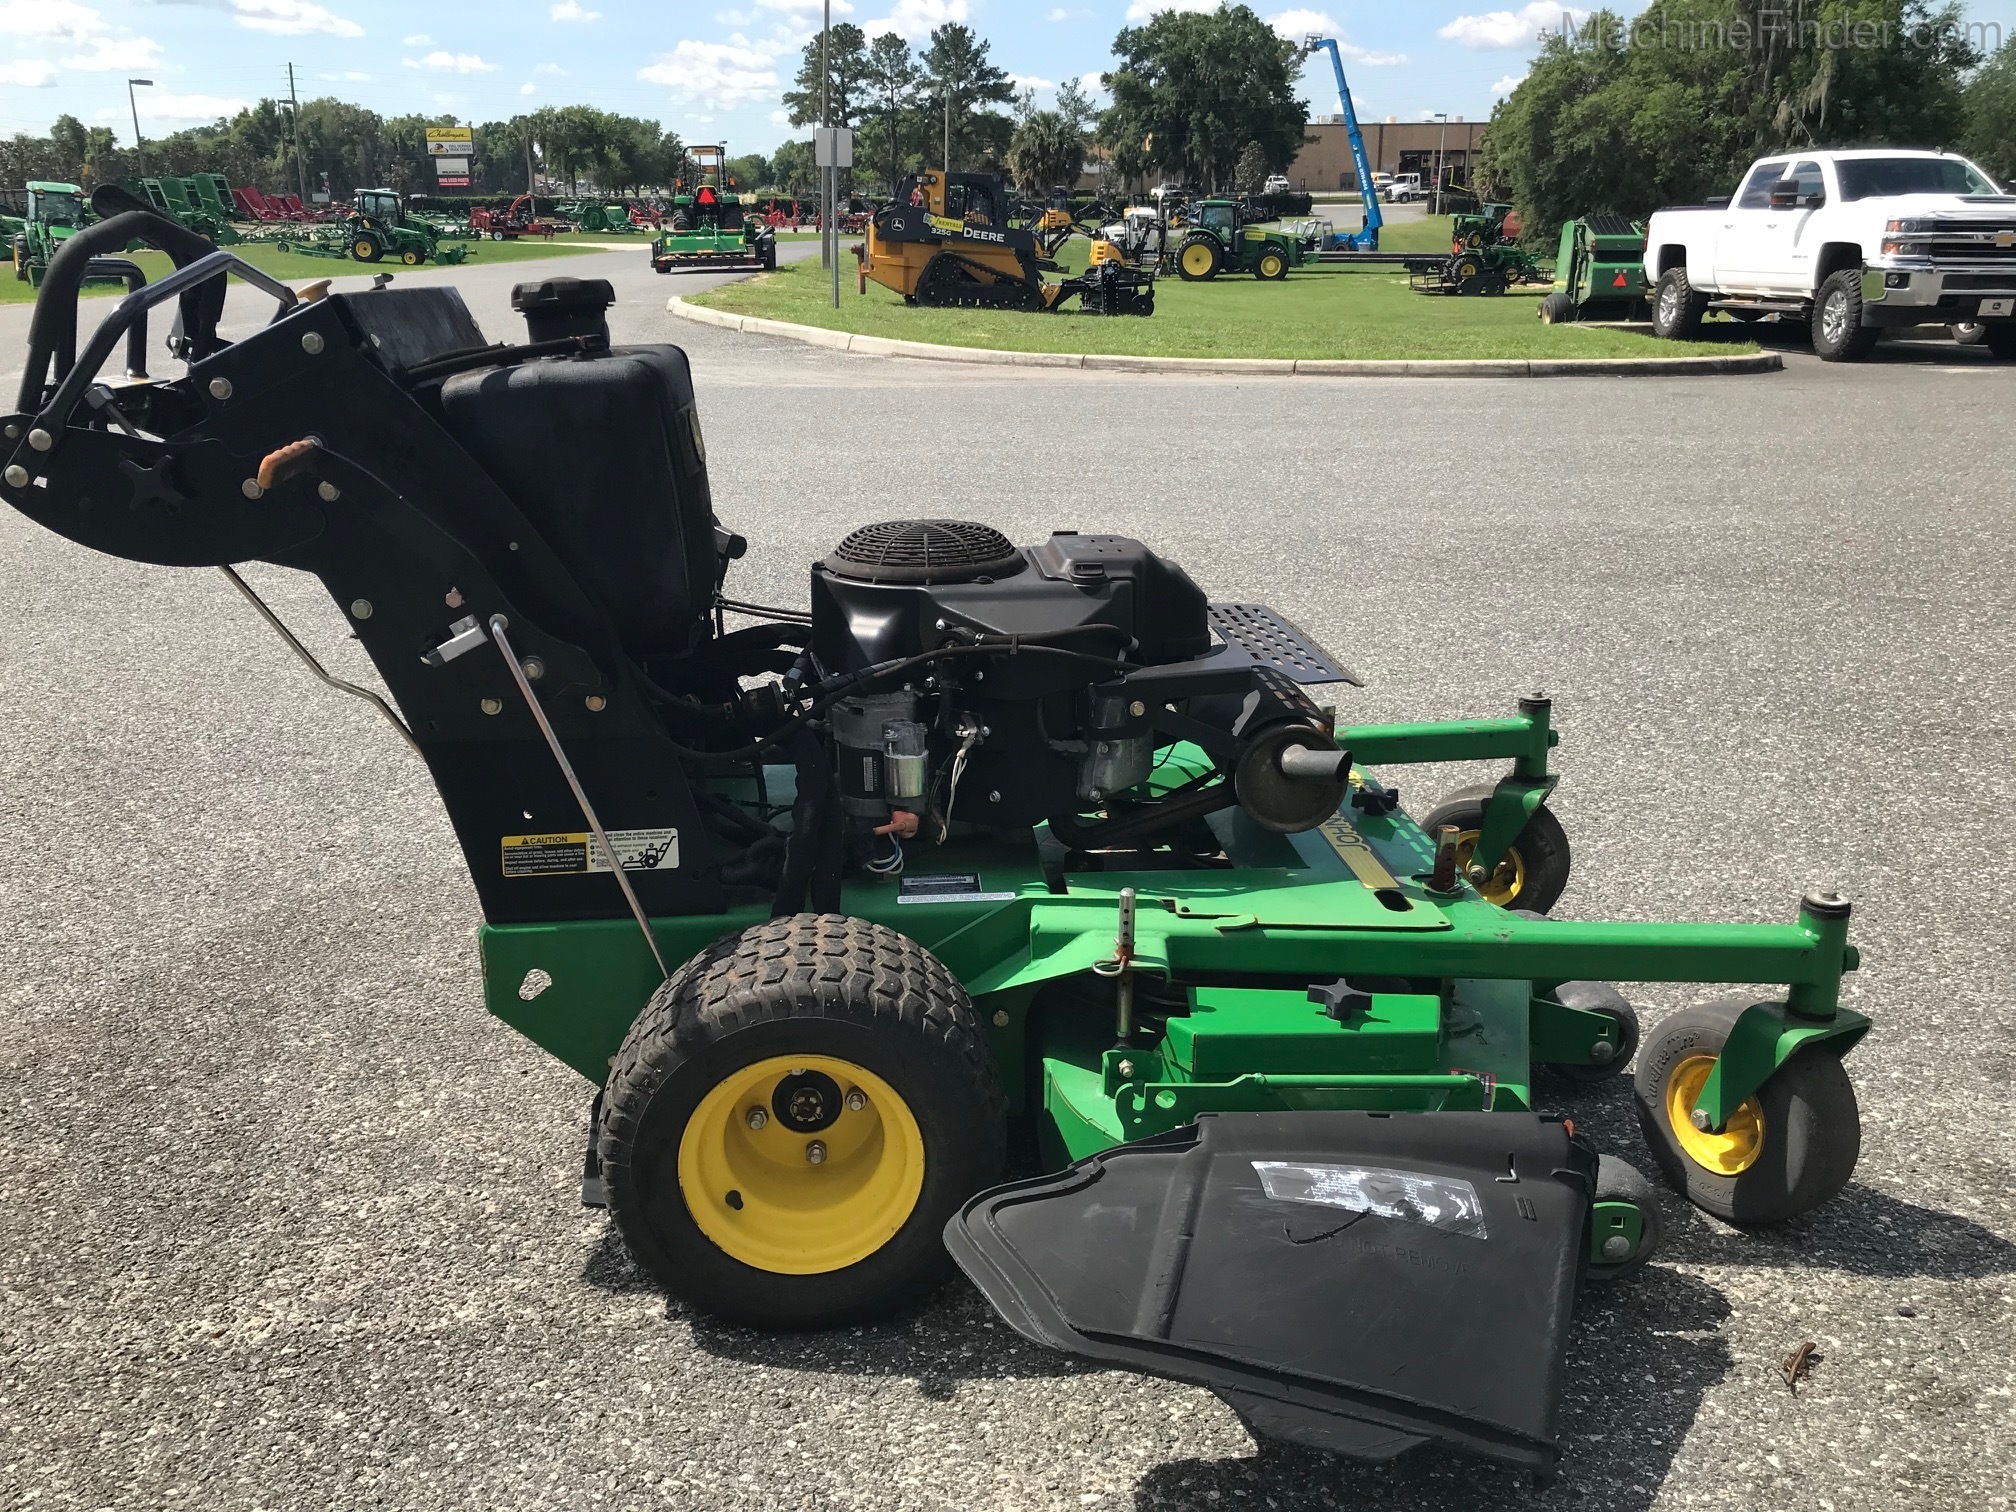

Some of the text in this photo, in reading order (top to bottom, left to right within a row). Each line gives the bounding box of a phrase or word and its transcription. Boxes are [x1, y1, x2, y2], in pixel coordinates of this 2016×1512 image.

[930, 227, 952, 236] 325G
[963, 227, 1005, 242] DEERE
[1354, 1237, 1389, 1258] NOT
